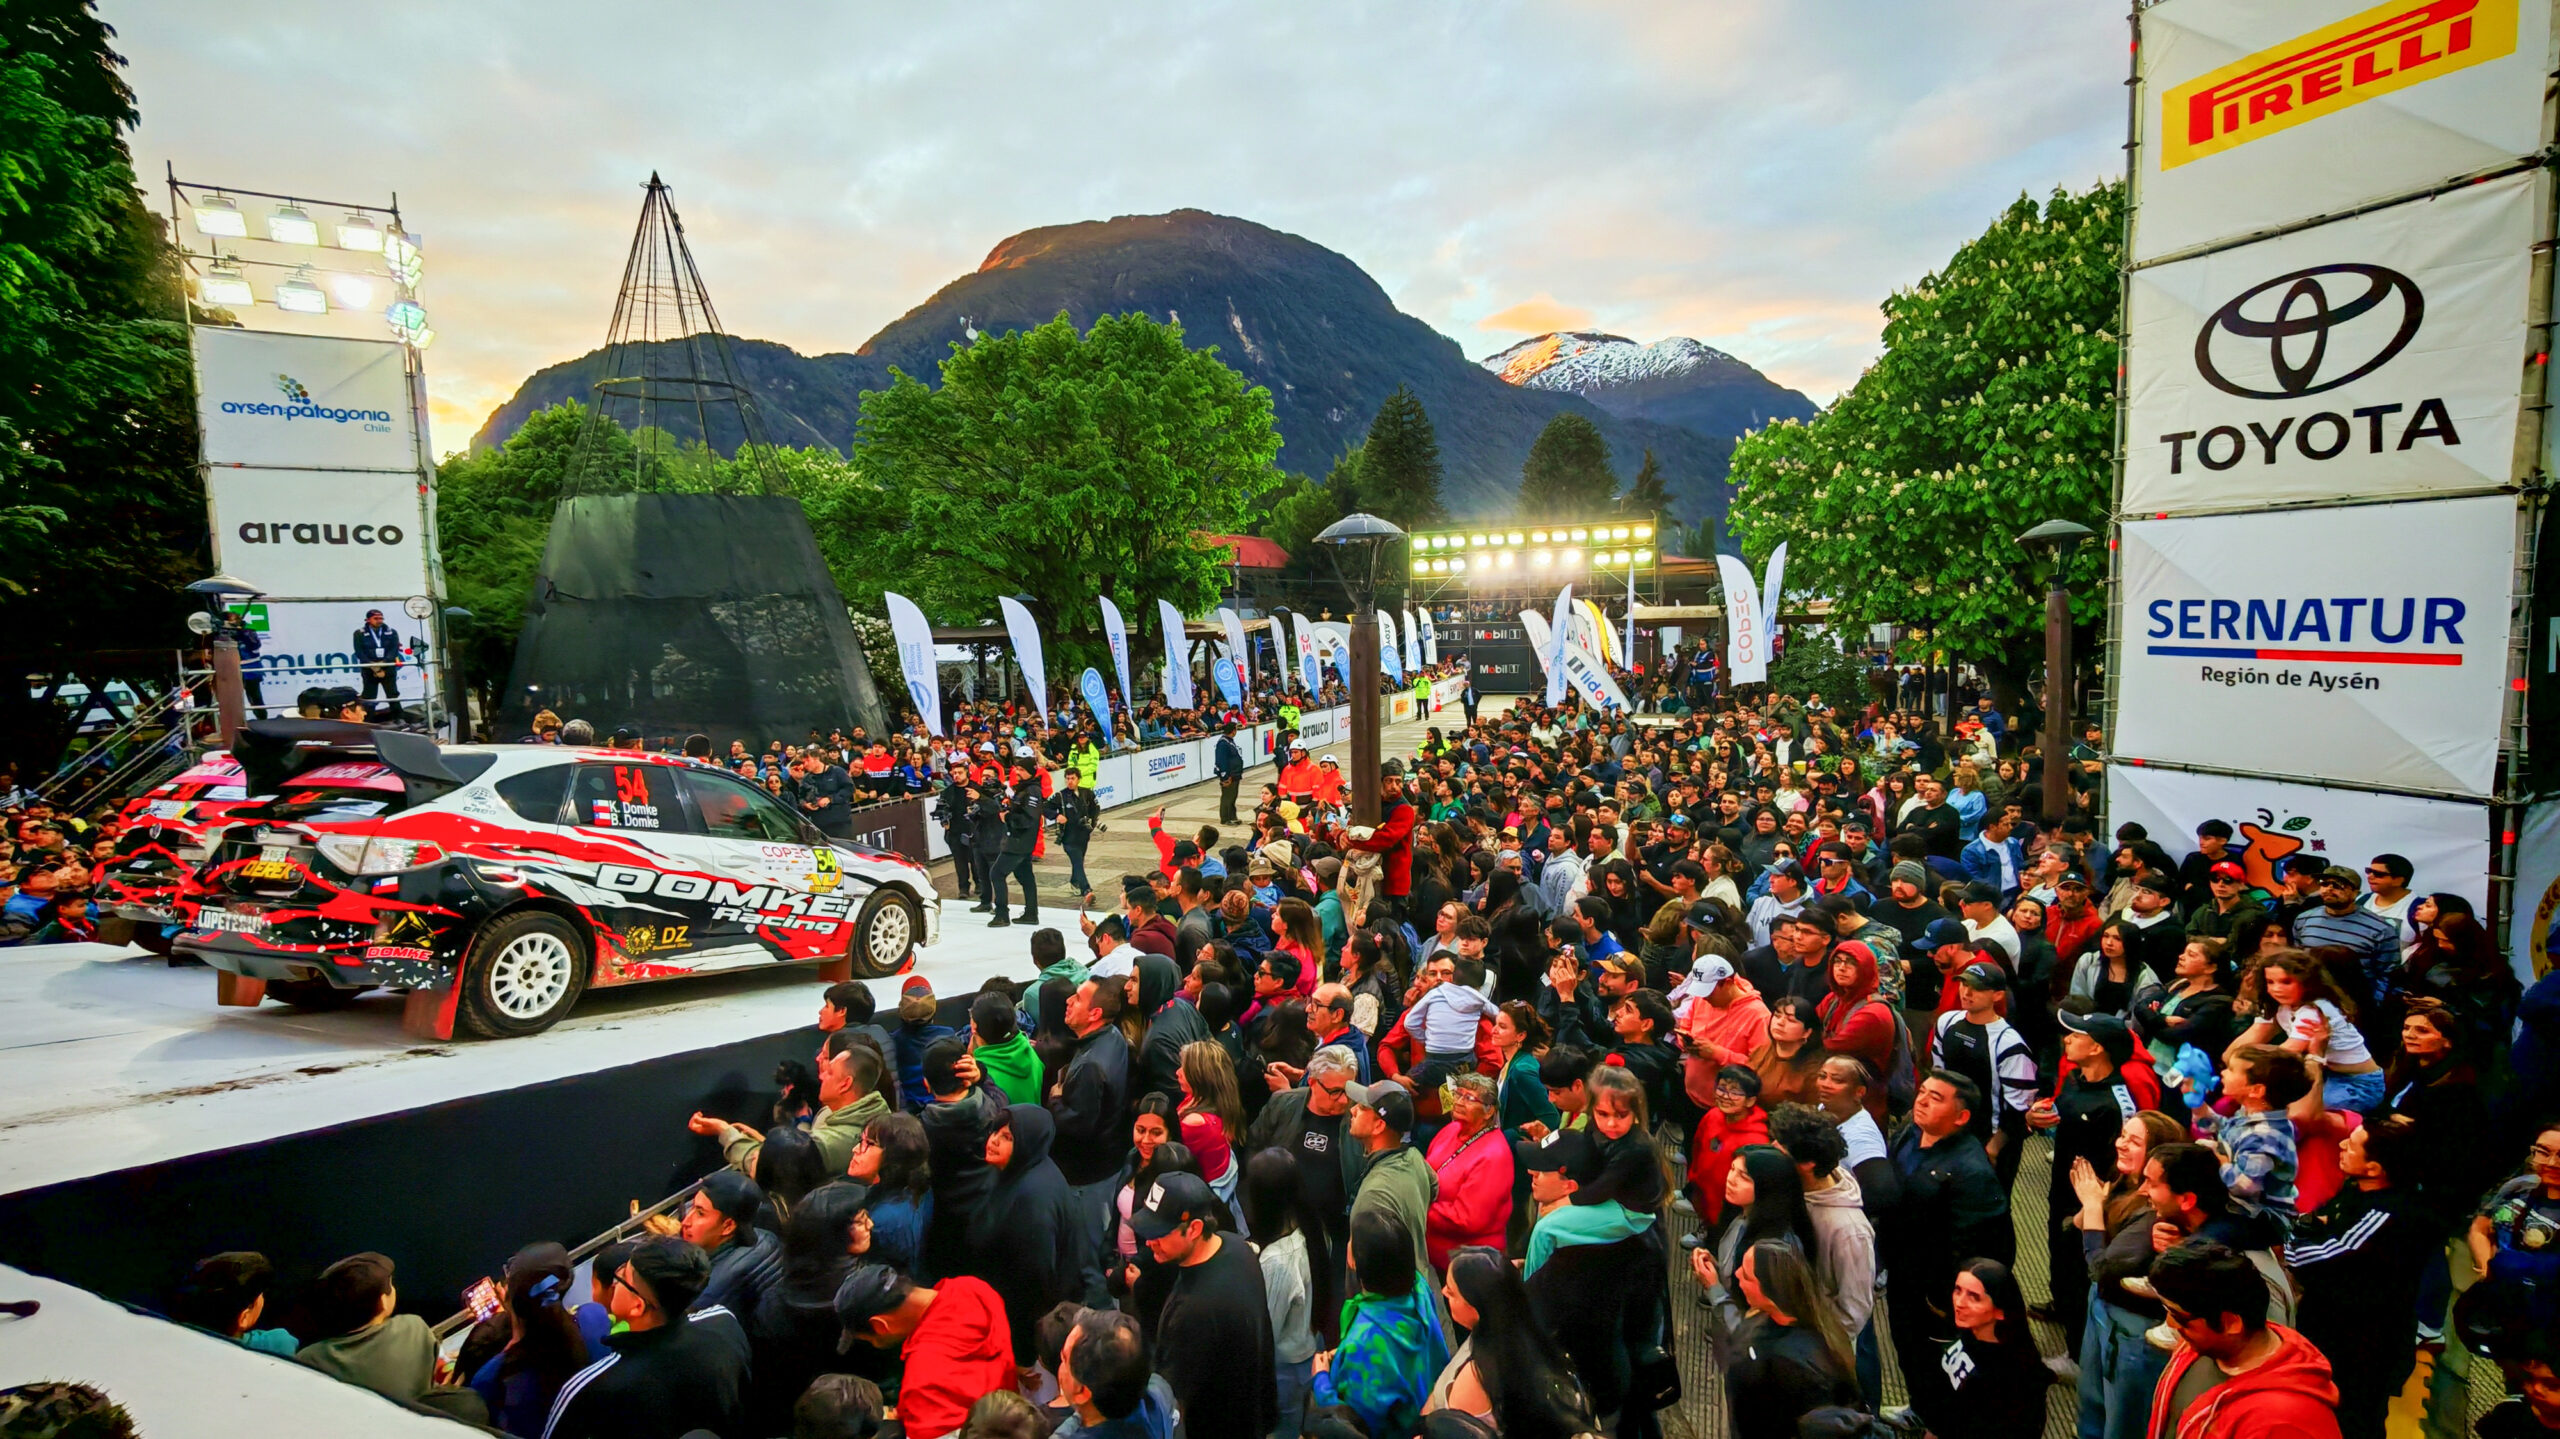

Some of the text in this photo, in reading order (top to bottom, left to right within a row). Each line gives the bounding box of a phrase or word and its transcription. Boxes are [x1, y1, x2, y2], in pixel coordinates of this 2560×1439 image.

[2188, 0, 2480, 146] PIRELLI
[363, 424, 392, 433] Chile
[2160, 398, 2460, 474] TOYOTA
[239, 522, 404, 545] arauco
[2147, 597, 2466, 644] SERNATUR
[1474, 629, 1508, 640] Mobil
[1479, 664, 1508, 674] Mobil
[2201, 666, 2380, 693] Región de Aysén
[1302, 721, 1329, 739] arauco
[1149, 752, 1186, 772] SERNATUR
[613, 765, 649, 805] 54
[609, 800, 658, 816] K. Domke
[611, 813, 660, 828] B. Domke
[762, 845, 811, 859] COPEC
[813, 849, 836, 872] 54
[240, 860, 296, 879] DEREK
[596, 863, 849, 918] DOMKE
[711, 906, 838, 935] Racing
[661, 925, 689, 945] DZ
[365, 946, 434, 961] DOMKE
